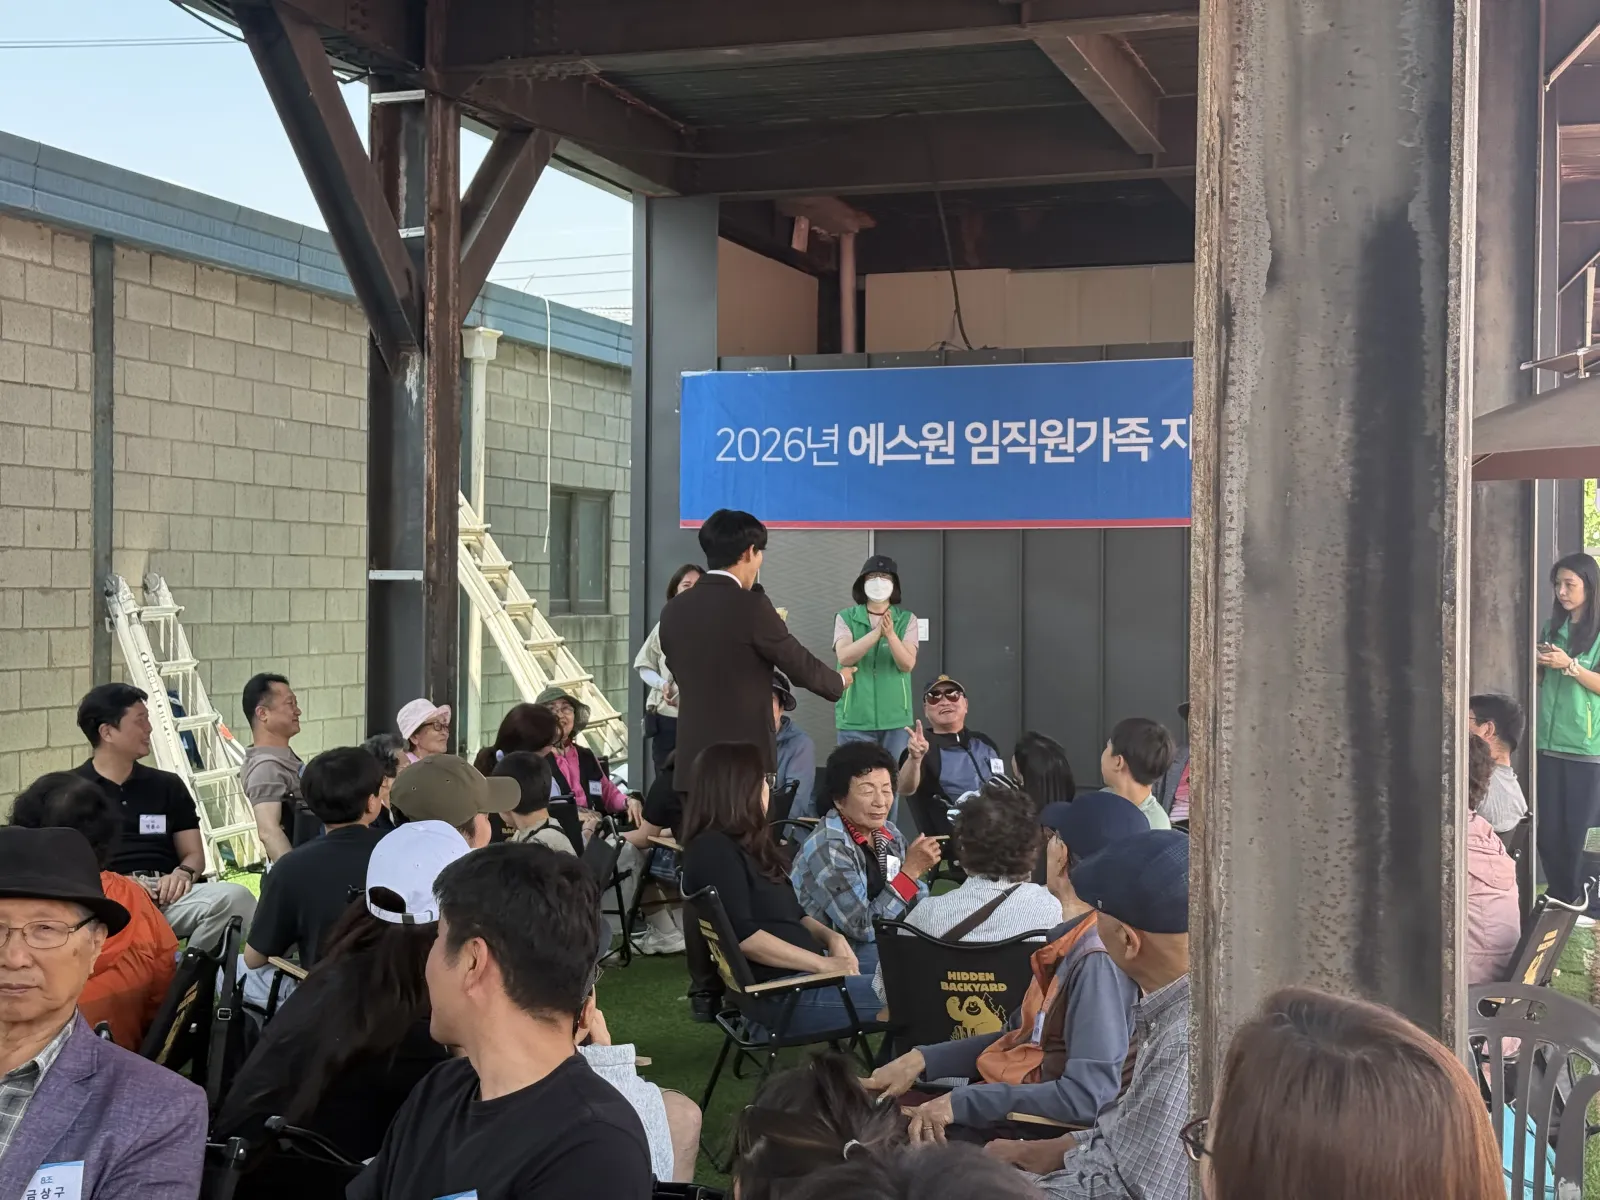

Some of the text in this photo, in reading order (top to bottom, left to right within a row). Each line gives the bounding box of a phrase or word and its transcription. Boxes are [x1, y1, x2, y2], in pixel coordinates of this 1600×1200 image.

[715, 423, 839, 466] 2026년
[848, 420, 955, 466] 에스원
[964, 416, 1154, 465] 임직원가족
[947, 971, 994, 981] HIDDEN
[940, 982, 1007, 992] BACKYARD
[40, 1175, 53, 1184] 8조
